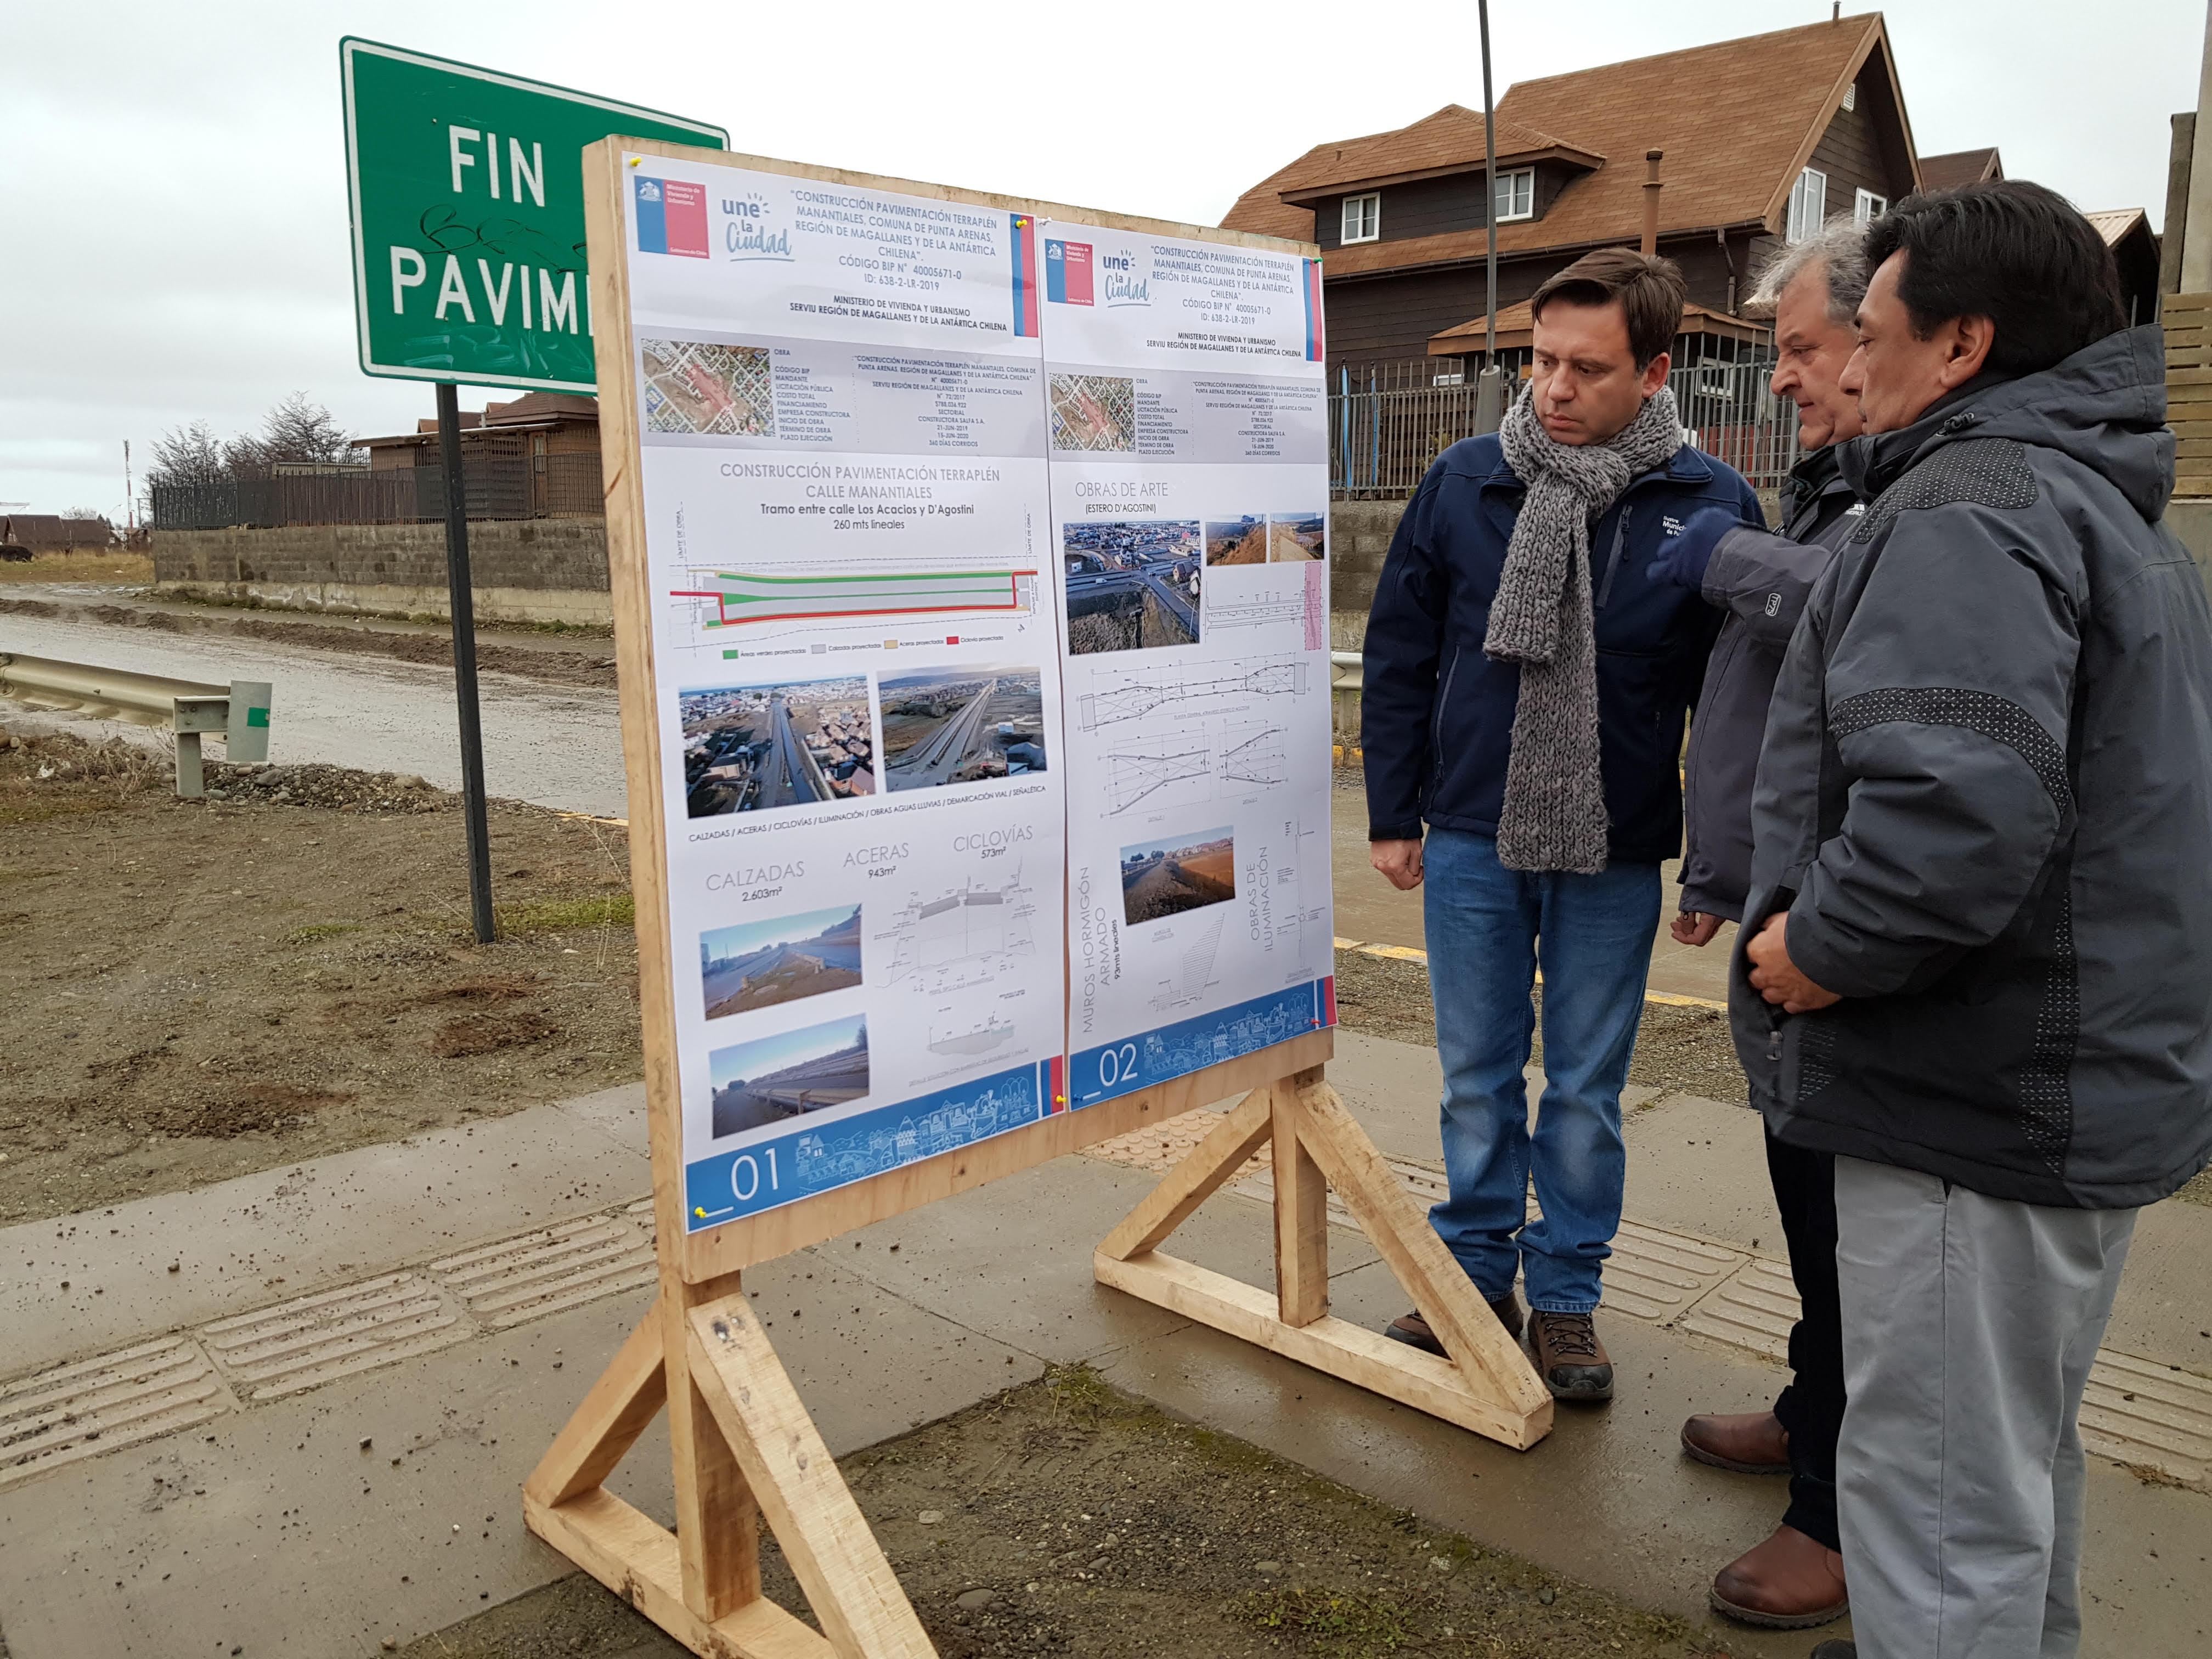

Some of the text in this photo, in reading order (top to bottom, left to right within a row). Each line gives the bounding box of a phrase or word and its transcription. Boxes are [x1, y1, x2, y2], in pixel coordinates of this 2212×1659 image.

[449, 125, 545, 207] FIN
[722, 199, 760, 218] une
[877, 202, 951, 222] PAVIMENTACIÓN
[953, 213, 997, 229] TERRAPLÉN
[741, 219, 753, 233] la
[797, 206, 993, 243] MANANTIALES, COMUNA DE PUNTA ARENAS,
[726, 222, 792, 256] Ciudad
[795, 220, 996, 256] REGIÓN DE MAGALLANES Y DE LA ANTÁRTICA
[838, 255, 879, 269] CÓDIGO
[882, 261, 895, 271] BIP
[913, 265, 962, 280] 40005671-0
[1103, 256, 1129, 270] une
[1154, 258, 1291, 283] MANANTIALES, COMUNA DE PUNTA ARENAS,
[1210, 252, 1263, 267] PAVIMENTACIÓN
[1264, 259, 1294, 272] TERRAPLÉN
[864, 273, 939, 291] ID: 638-2-LR-2019
[1105, 275, 1149, 301] Ciudad
[1115, 272, 1123, 283] la
[1152, 270, 1294, 294] REGIÓN DE MAGALLANES Y DE LA ANTÁRTICA
[390, 245, 594, 336] PAVIM
[790, 302, 816, 313] SERVIU
[819, 305, 848, 315] REGIÓN
[850, 308, 860, 317] DE
[862, 309, 911, 322] MAGALLANES
[919, 315, 929, 324] DE
[930, 317, 939, 325] LA
[940, 317, 978, 329] ANTÁRTICA
[979, 321, 1007, 331] CHILENA
[833, 295, 874, 307] MINISTERIO
[877, 300, 887, 308] DE
[888, 301, 922, 312] VIVIENDA
[930, 305, 970, 317] URBANISMO
[1182, 297, 1212, 309] CÓDIGO
[1213, 301, 1223, 311] BIP
[1235, 303, 1271, 315] 40005671-0
[1200, 312, 1255, 325] ID: 638-2-LR-2019
[1147, 340, 1165, 348] SERVIU
[1198, 343, 1234, 352] MAGALLANES
[1254, 346, 1280, 356] ANTÁRTICA
[1177, 332, 1208, 341] MINISTERIO
[1217, 335, 1242, 343] VIVIENDA
[1248, 337, 1276, 346] URBANISMO
[720, 463, 1000, 481] CONSTRUCCIÓN PAVIMENTACIÓN TERRAPLÉN
[806, 485, 932, 499] CALLE MANANTIALES
[1075, 482, 1169, 496] OBRAS DE ARTE
[760, 503, 974, 517] Tramo entre calle Los Acacios y D'Agostini
[1086, 503, 1156, 515] (ESTERO D'AGOSTINI)
[833, 519, 905, 529] 260 mts lineales
[688, 830, 730, 842] CALZADAS
[736, 824, 767, 835] ACERAS
[773, 817, 812, 830] CICLOVÍAS
[819, 810, 864, 823] ILUMINACIÓN
[870, 806, 892, 816] OBRAS
[893, 803, 916, 812] AGUAS
[917, 799, 941, 809] LLUVIAS
[947, 791, 994, 805] DEMARCACIÓN
[1013, 785, 1046, 796] SEÑALÉTICA
[953, 824, 1034, 853] CICLOVÍAS
[844, 843, 910, 867] ACERAS
[706, 861, 805, 891] CALZADAS
[1246, 862, 1261, 941] OBRAS DE
[1257, 846, 1273, 952] ILUMINACIÓN
[1080, 867, 1096, 1033] MUROS HORMIGÓN
[1095, 907, 1110, 986] ARMADO
